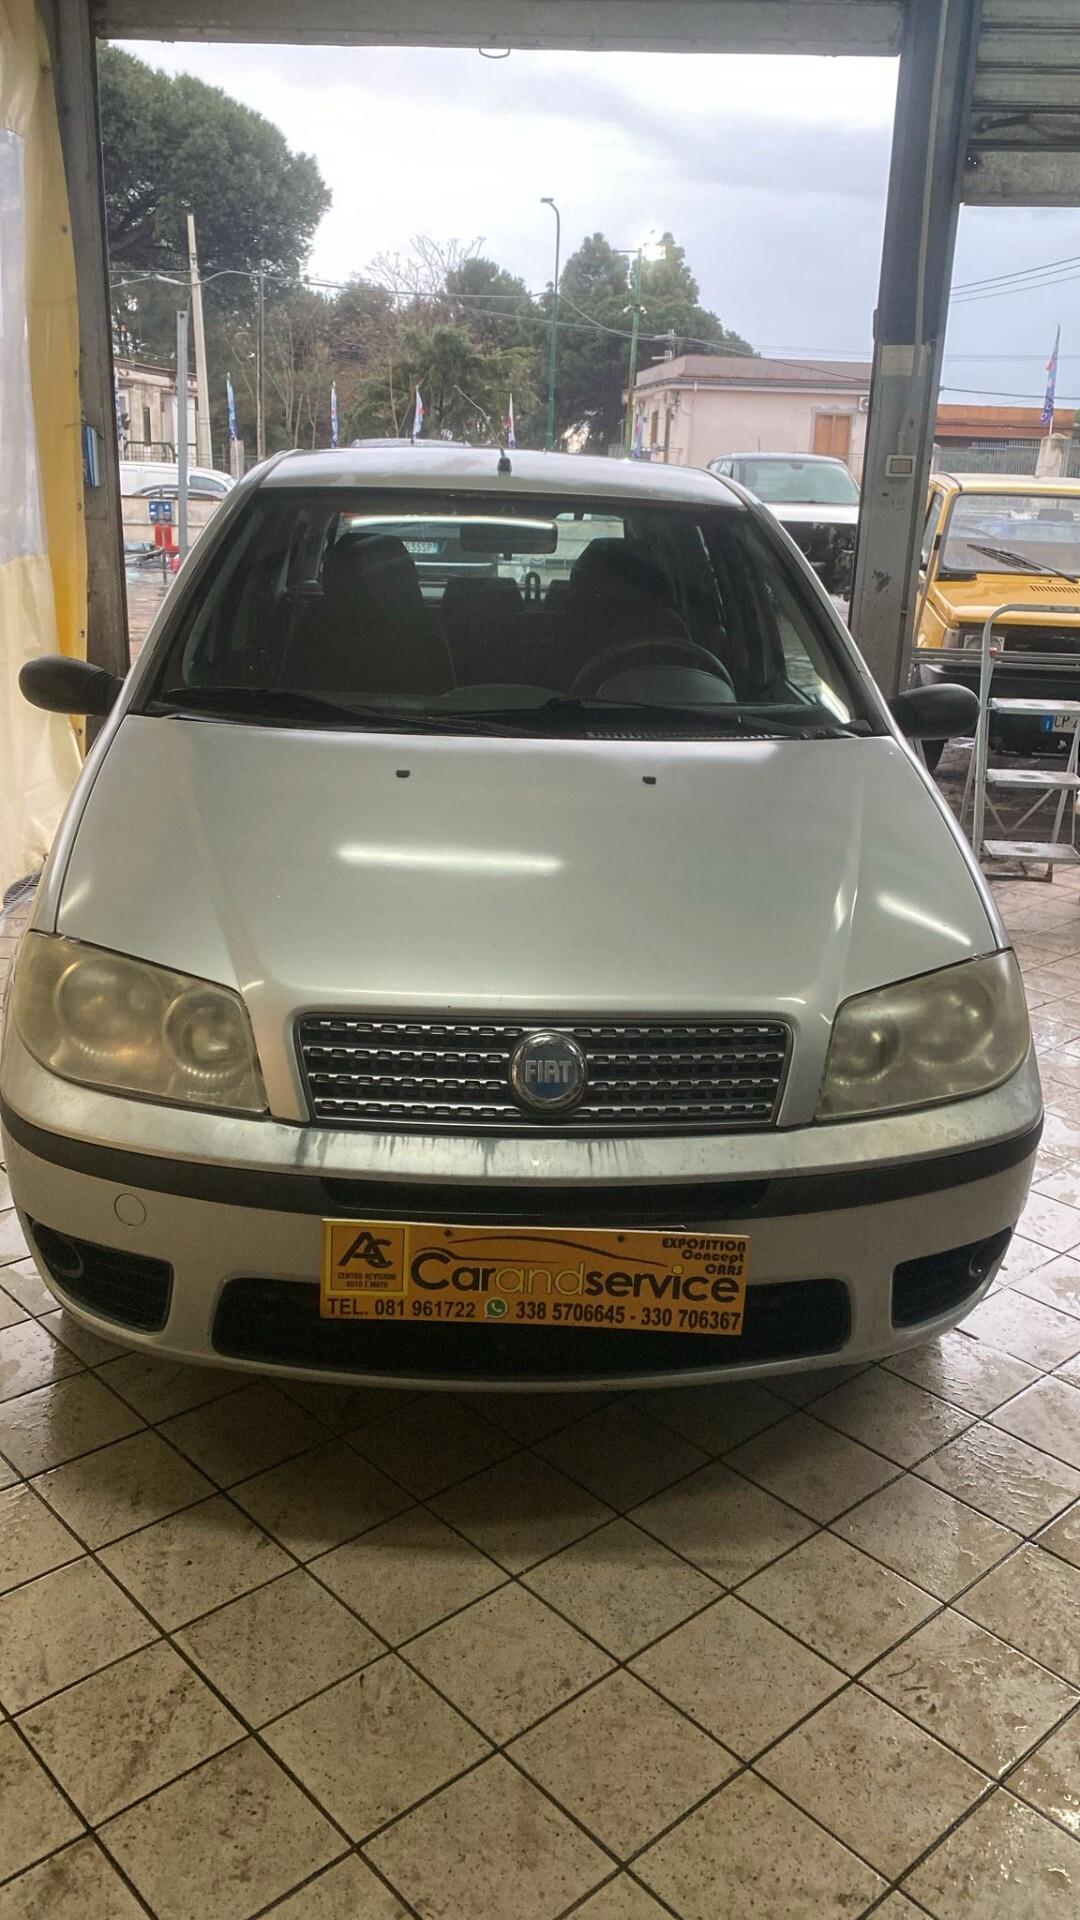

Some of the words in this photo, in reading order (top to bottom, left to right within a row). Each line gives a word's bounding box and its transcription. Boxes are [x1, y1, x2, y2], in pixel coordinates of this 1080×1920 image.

[525, 1060, 572, 1083] FIAT
[662, 1237, 746, 1251] EXPOSITION
[681, 1250, 744, 1263] Concept
[705, 1264, 743, 1276] CARS
[327, 1298, 369, 1316] TEL.
[374, 1299, 405, 1317] 081
[412, 1300, 475, 1319] 961722
[516, 1301, 547, 1319] 338
[552, 1303, 625, 1324] 5706645
[641, 1307, 672, 1327] 330
[678, 1309, 741, 1331] 706367
